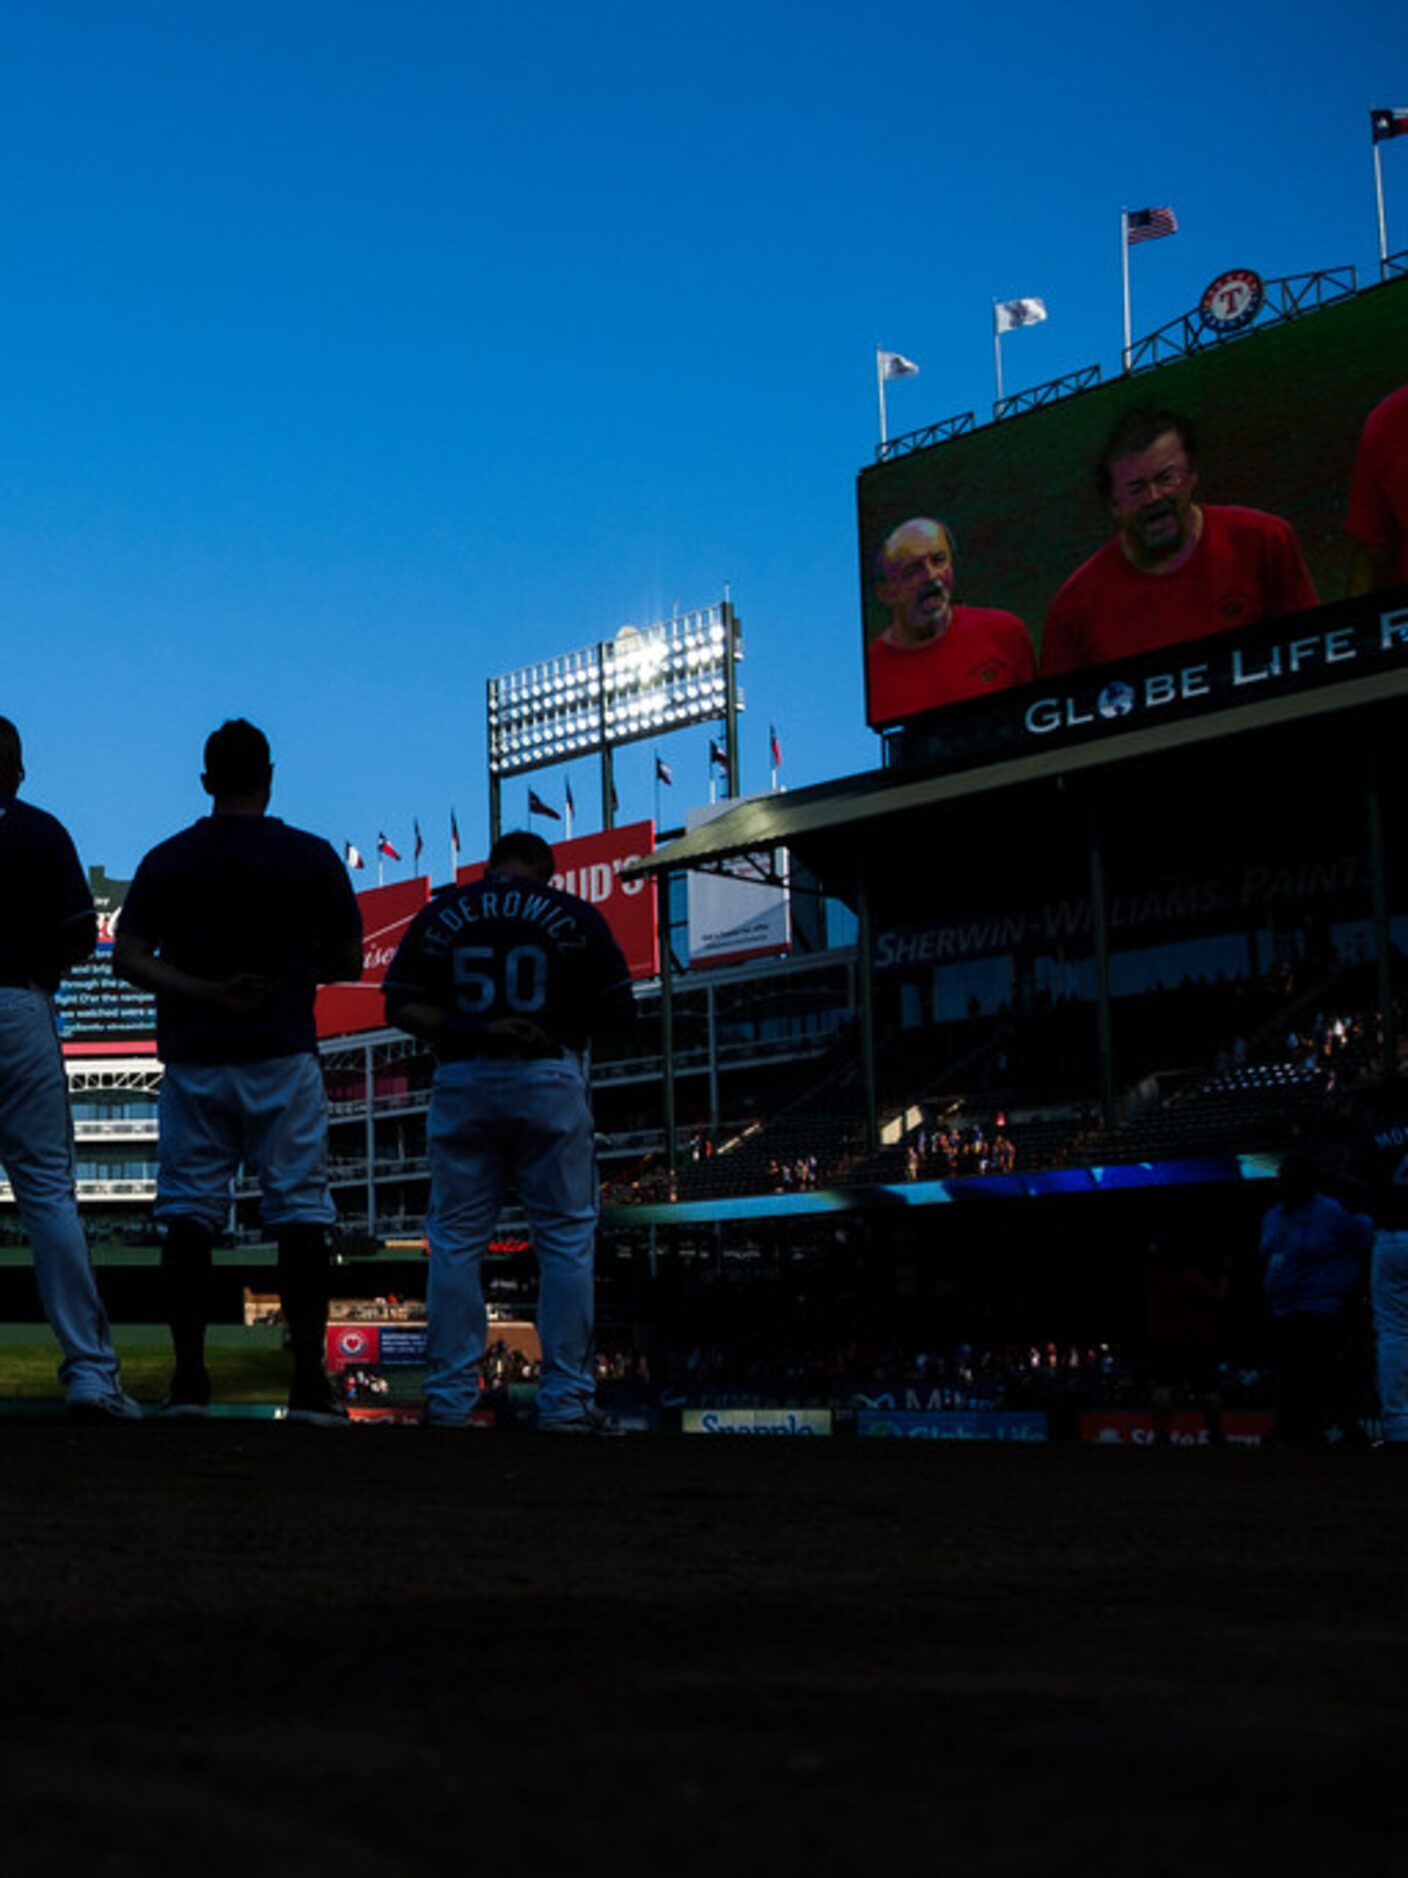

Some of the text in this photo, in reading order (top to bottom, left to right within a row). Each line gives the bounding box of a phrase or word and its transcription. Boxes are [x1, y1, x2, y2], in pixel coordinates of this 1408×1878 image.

[1219, 286, 1243, 315] T
[1023, 663, 1212, 735] GLOBE
[1230, 626, 1359, 687] LIFE
[873, 853, 1372, 970] SHERWIN-WILIAMS PAINT
[450, 943, 550, 1014] 50
